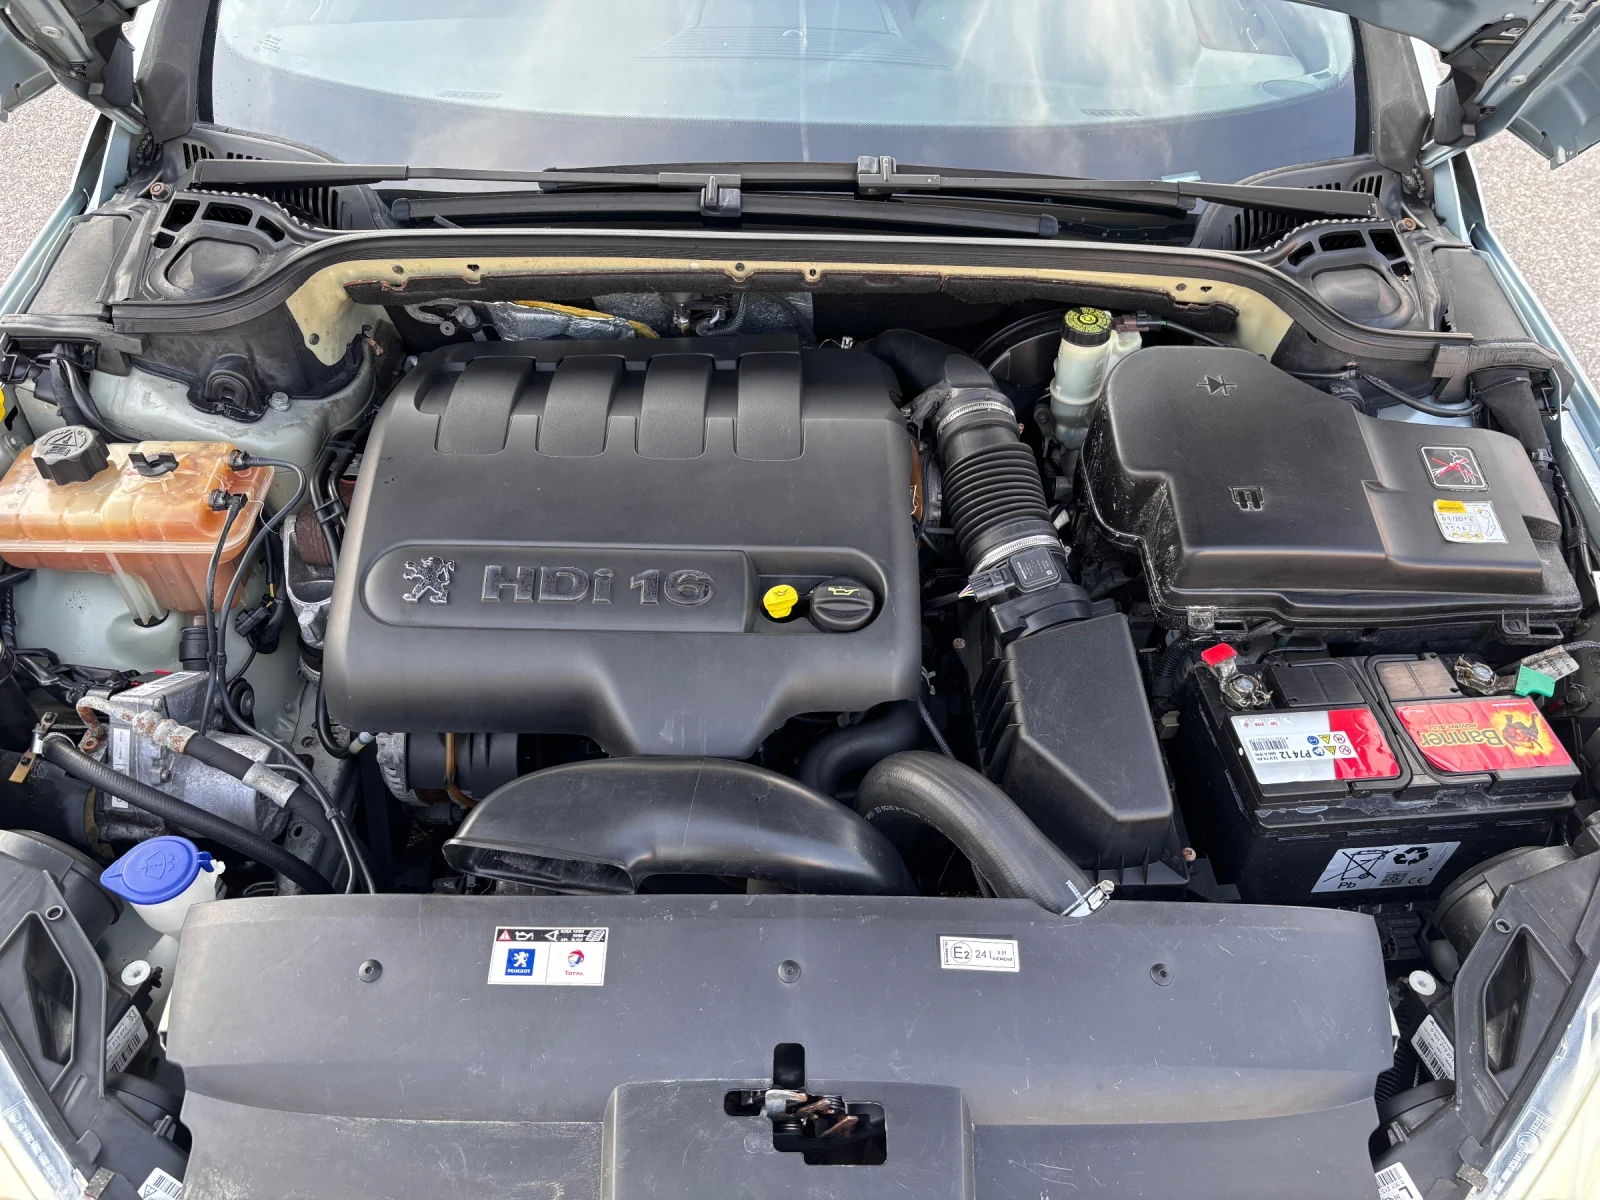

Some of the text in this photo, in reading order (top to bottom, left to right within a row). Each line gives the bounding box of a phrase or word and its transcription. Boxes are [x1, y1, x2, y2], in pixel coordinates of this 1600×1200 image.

[481, 565, 714, 607] HDi 16
[1421, 729, 1504, 747] Banner
